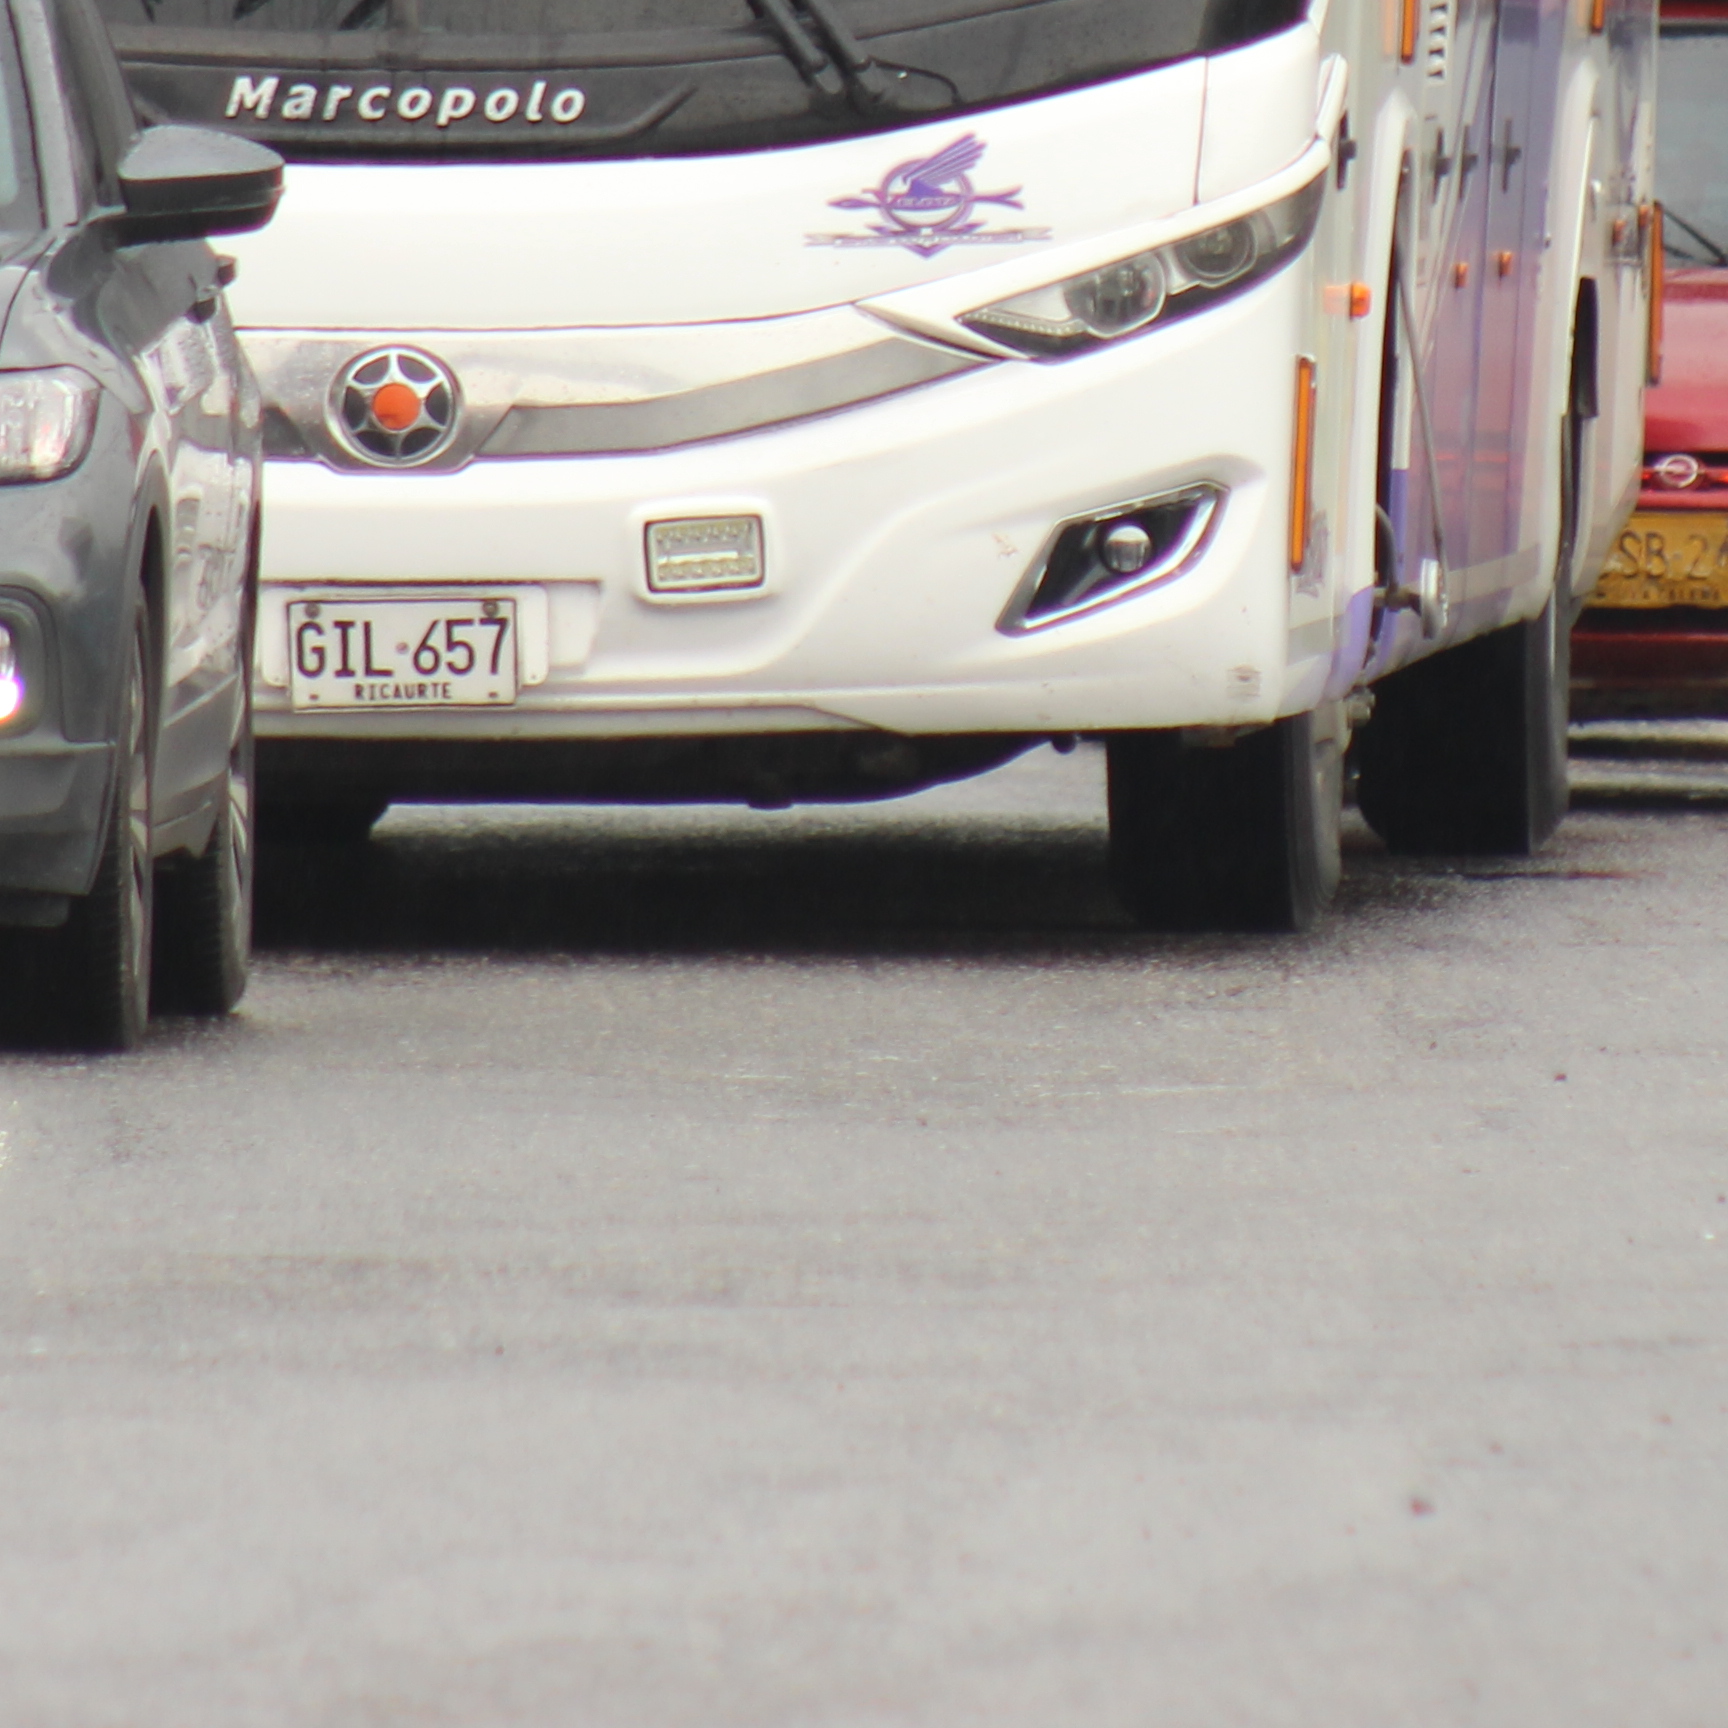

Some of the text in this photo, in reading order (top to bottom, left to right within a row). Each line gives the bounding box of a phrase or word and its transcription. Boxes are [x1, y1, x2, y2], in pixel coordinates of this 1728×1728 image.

[225, 76, 586, 127] Marcopolo
[1599, 530, 1668, 579] SB
[296, 617, 510, 678] GIL 657
[354, 681, 453, 701] RICAURTE
